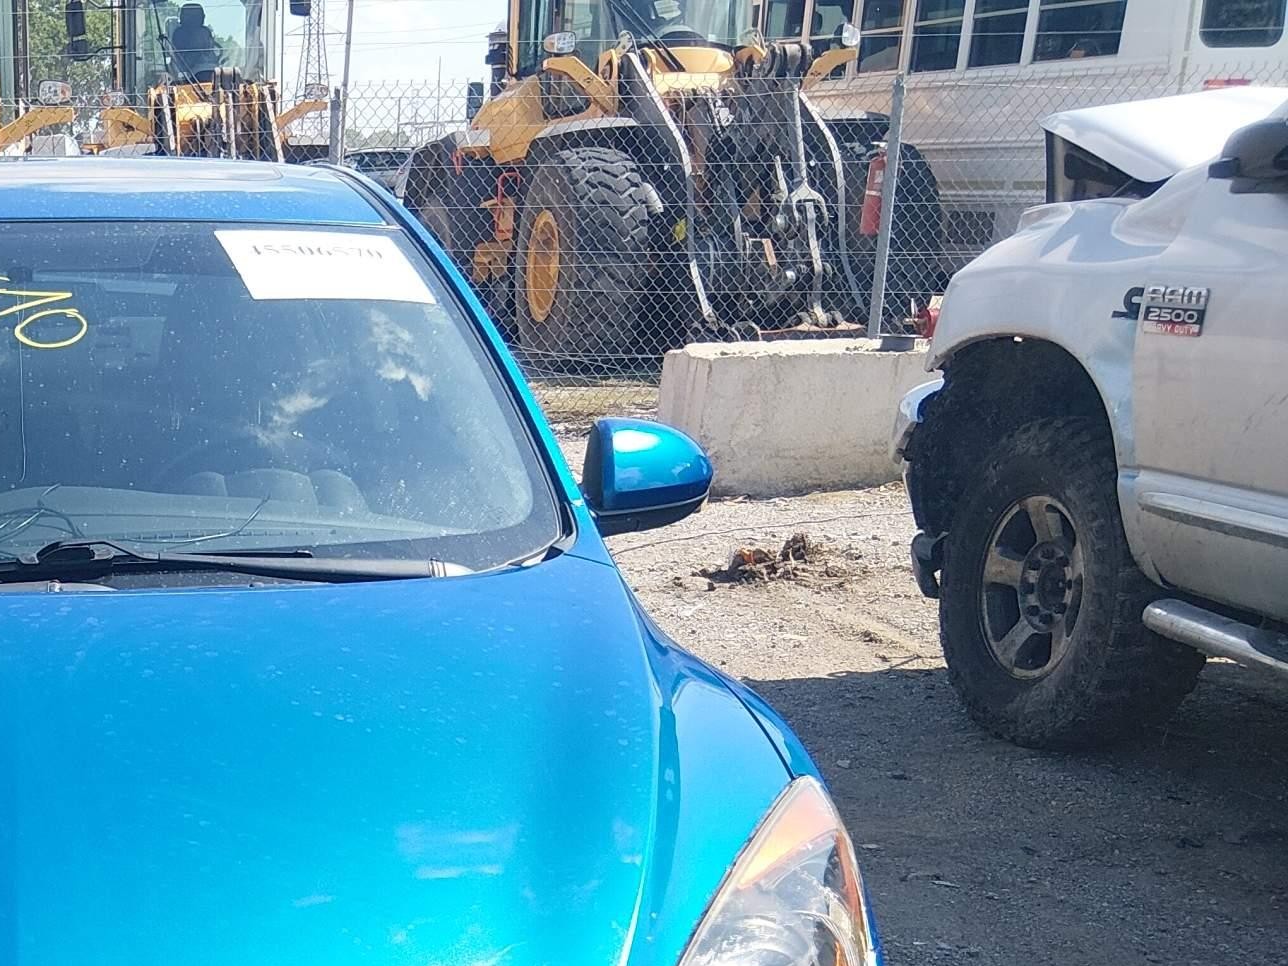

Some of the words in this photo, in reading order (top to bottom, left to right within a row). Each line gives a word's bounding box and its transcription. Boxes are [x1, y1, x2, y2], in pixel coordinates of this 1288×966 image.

[1146, 286, 1208, 304] RAM
[1147, 308, 1198, 323] 2500
[1149, 321, 1173, 333] AVY
